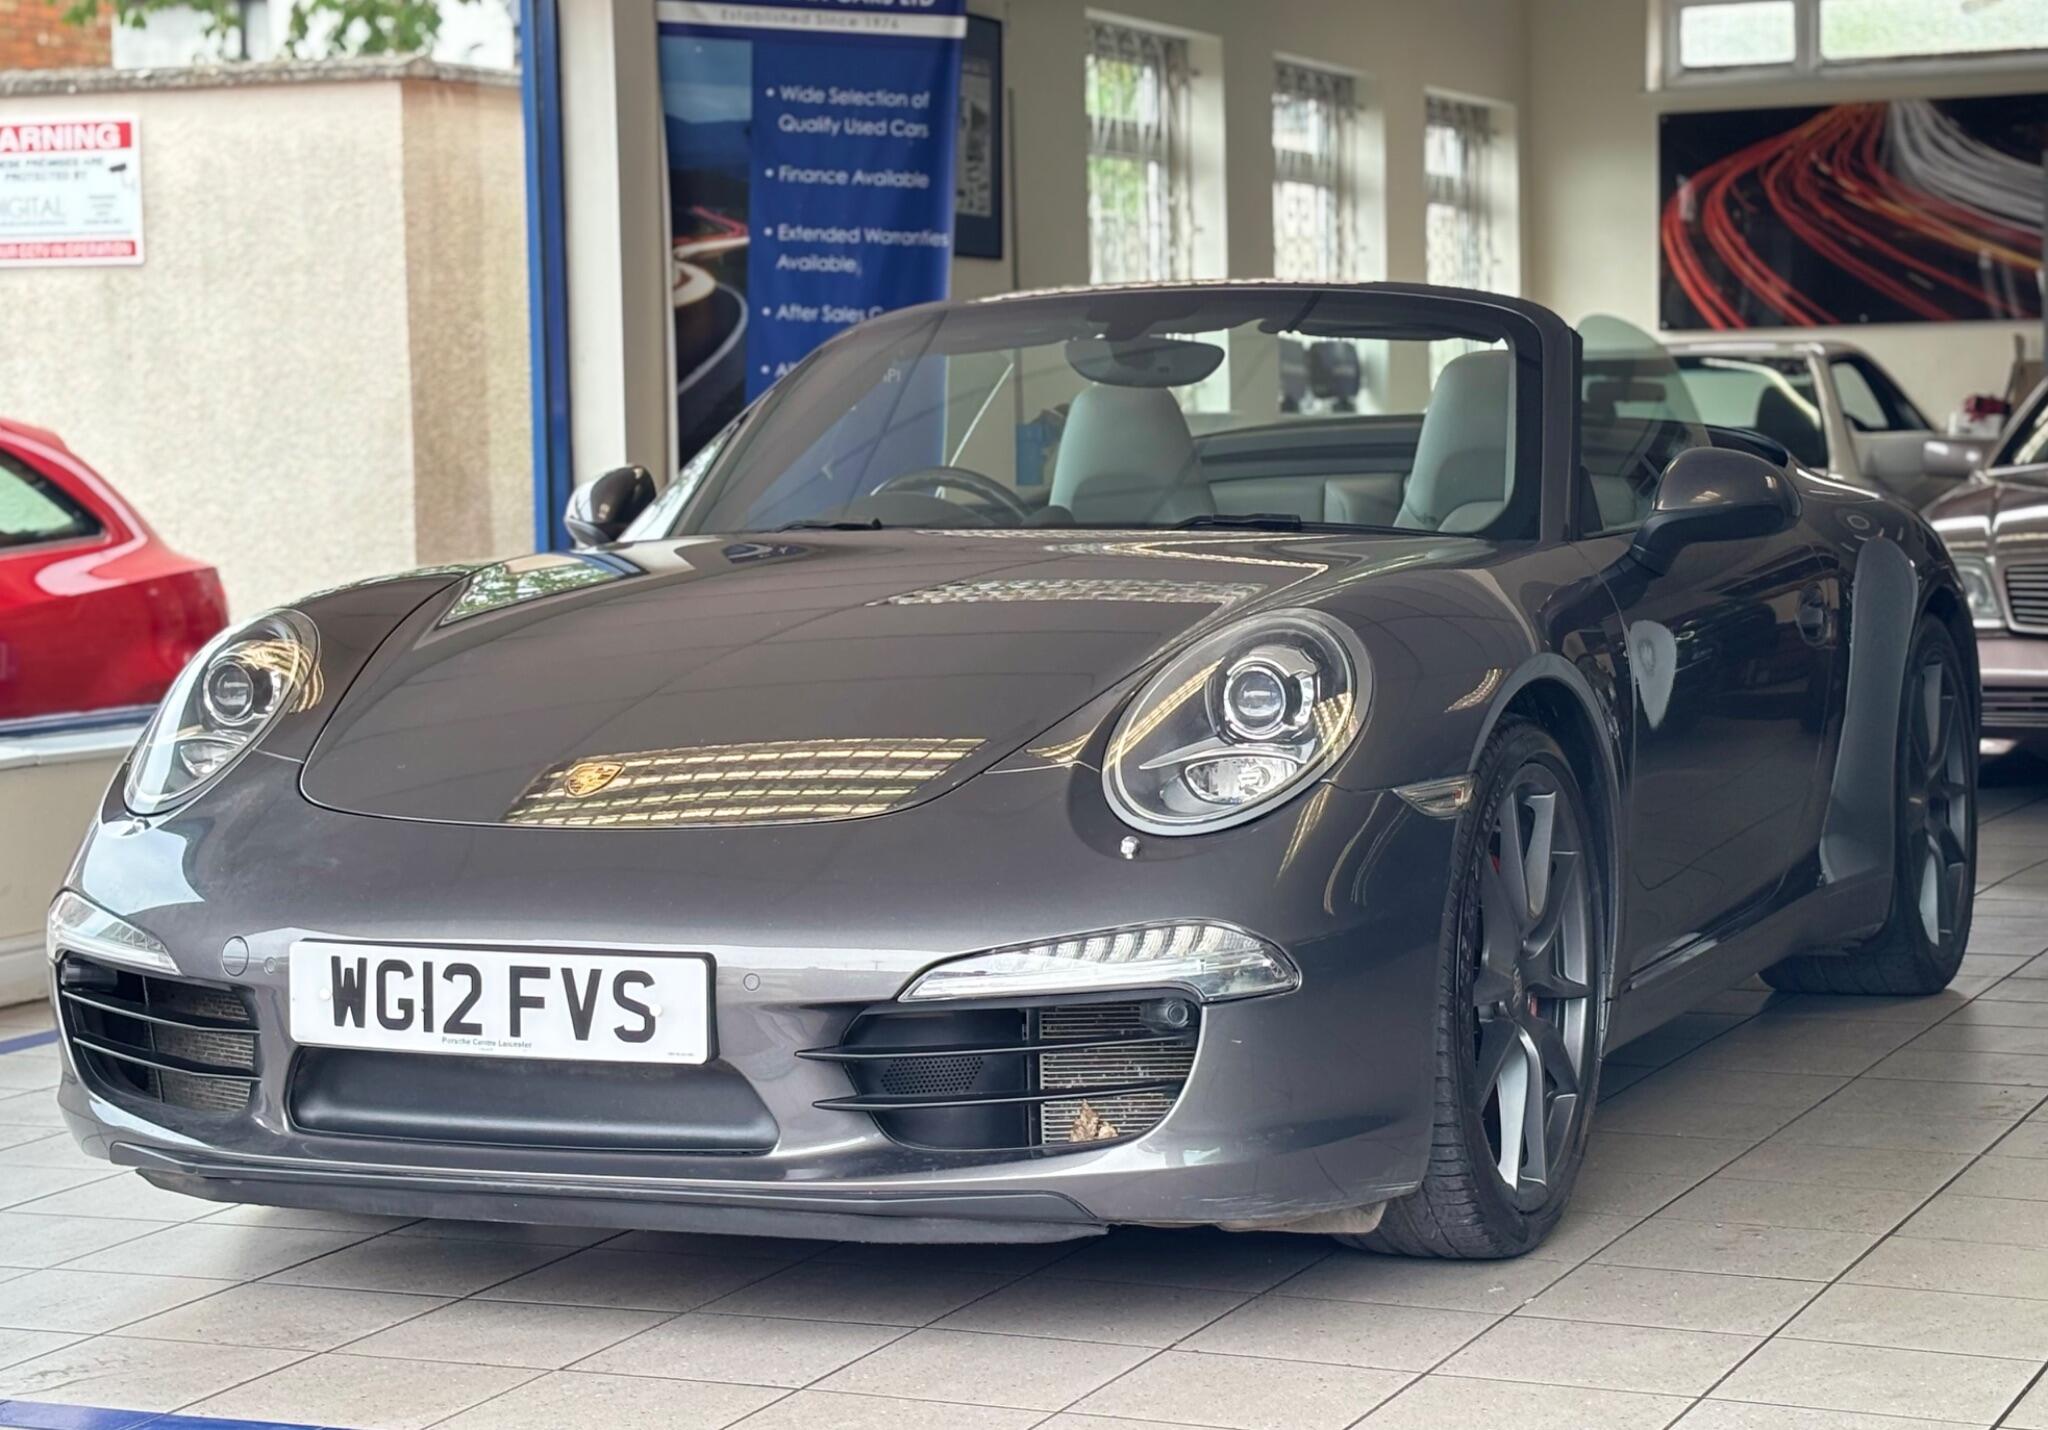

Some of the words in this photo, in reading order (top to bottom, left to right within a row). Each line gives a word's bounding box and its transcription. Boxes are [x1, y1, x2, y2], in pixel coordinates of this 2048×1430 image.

[721, 9, 811, 25] Established
[815, 12, 857, 27] Since
[779, 85, 826, 104] Wide
[829, 86, 908, 107] Selection
[911, 90, 930, 109] of
[0, 123, 120, 152] ARNING
[778, 113, 842, 137] Quality
[844, 117, 887, 136] Used
[890, 119, 929, 138] Cars
[778, 164, 848, 185] Finance
[852, 169, 930, 189] Available
[777, 223, 860, 244] Extended
[864, 227, 949, 248] Warranties
[775, 303, 818, 321] After
[821, 304, 867, 323] Sales
[331, 955, 483, 1035] WG12
[509, 965, 656, 1043] FVS
